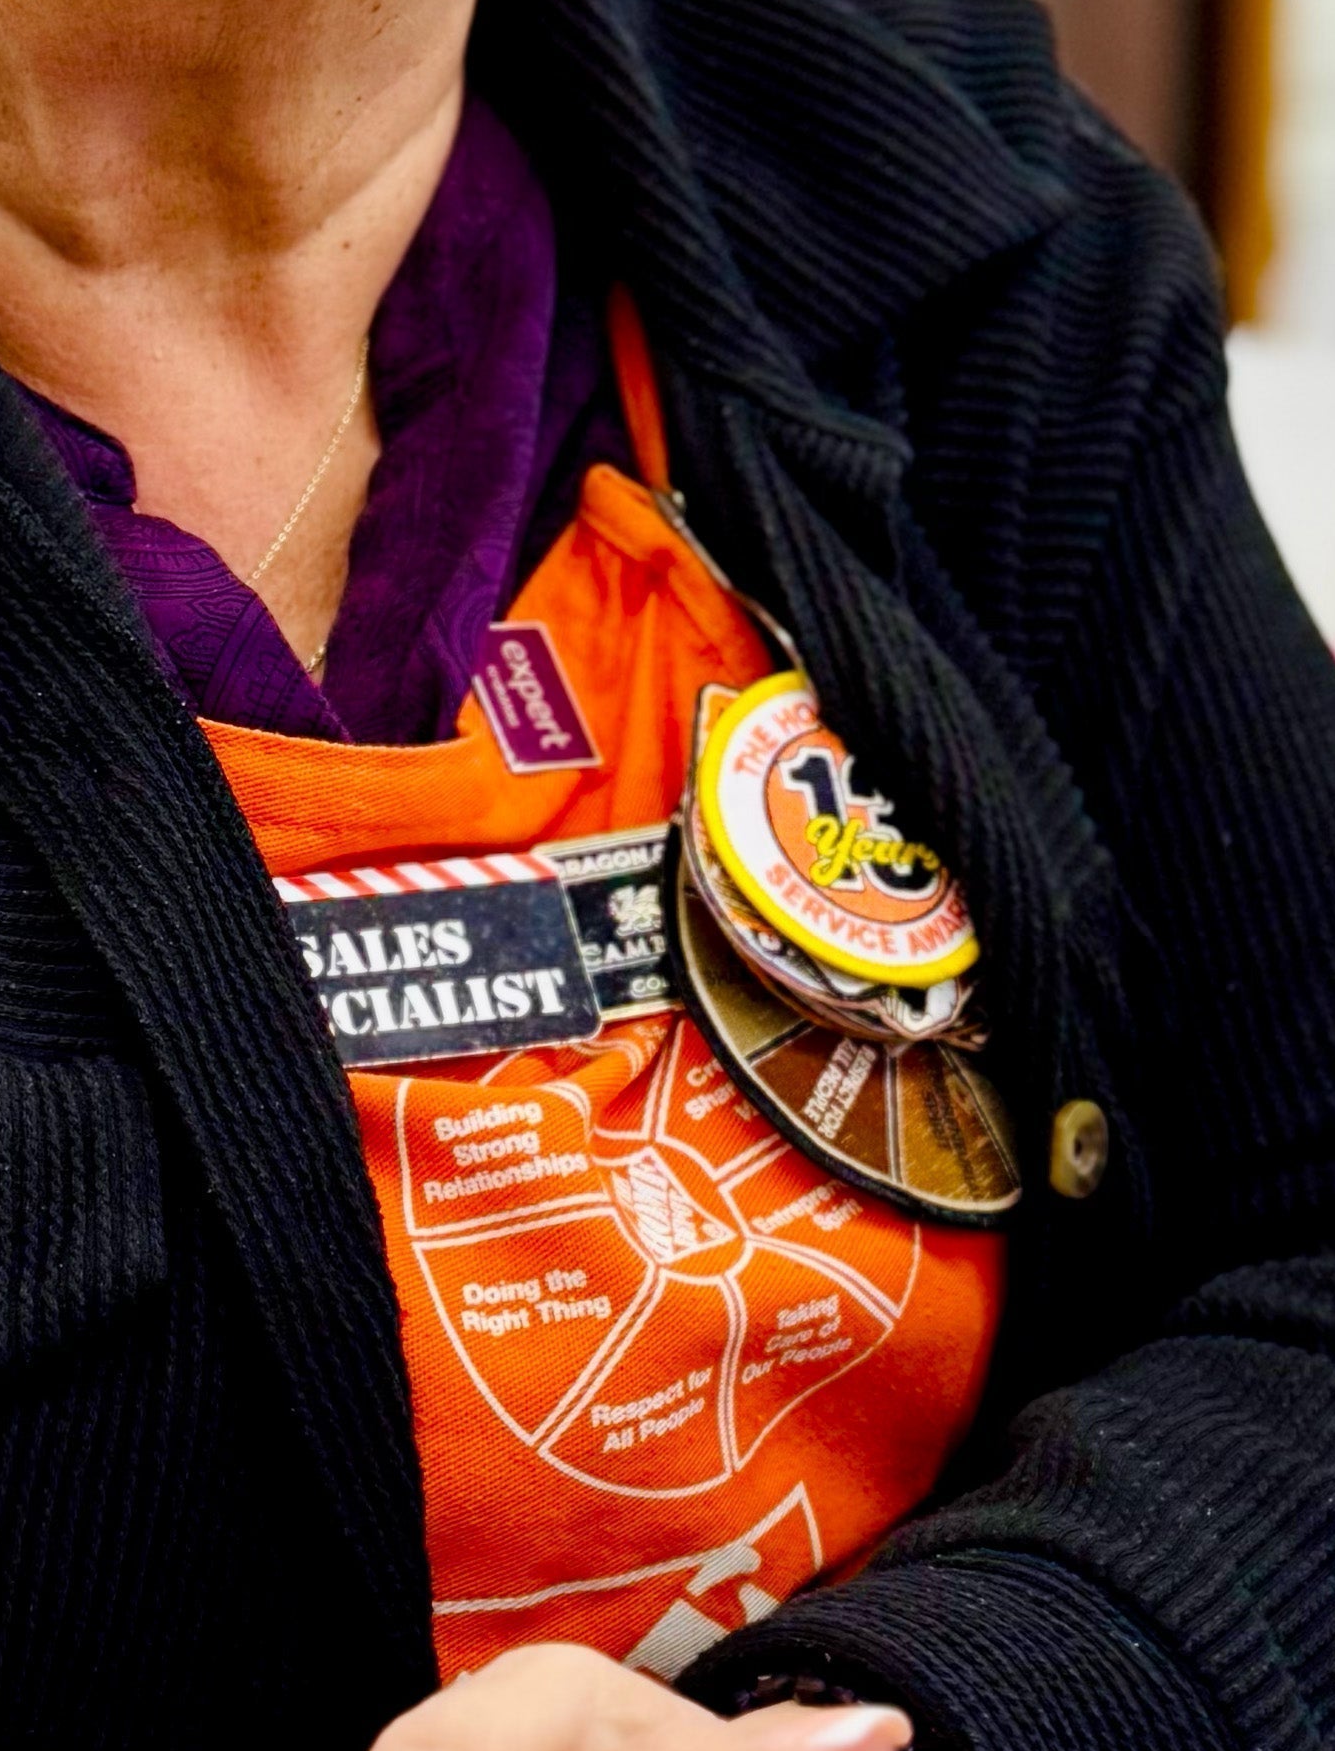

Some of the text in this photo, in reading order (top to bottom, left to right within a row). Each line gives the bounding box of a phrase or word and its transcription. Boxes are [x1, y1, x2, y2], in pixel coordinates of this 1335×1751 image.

[500, 640, 572, 751] expert
[732, 701, 819, 778] THE HO
[805, 814, 941, 888] Years
[766, 863, 972, 958] SERVICE AWAR
[295, 918, 473, 980] SALES
[320, 967, 566, 1037] CIALIST
[434, 1101, 543, 1142] Building
[452, 1129, 541, 1167] Strong
[423, 1152, 589, 1204] Relationships
[461, 1268, 588, 1307] Doing the
[776, 1294, 840, 1330] Taking
[461, 1294, 612, 1337] Right Thing
[765, 1314, 842, 1353] Care of
[741, 1336, 853, 1385] Our People
[589, 1367, 713, 1429] Respect for
[602, 1397, 706, 1454] All People
